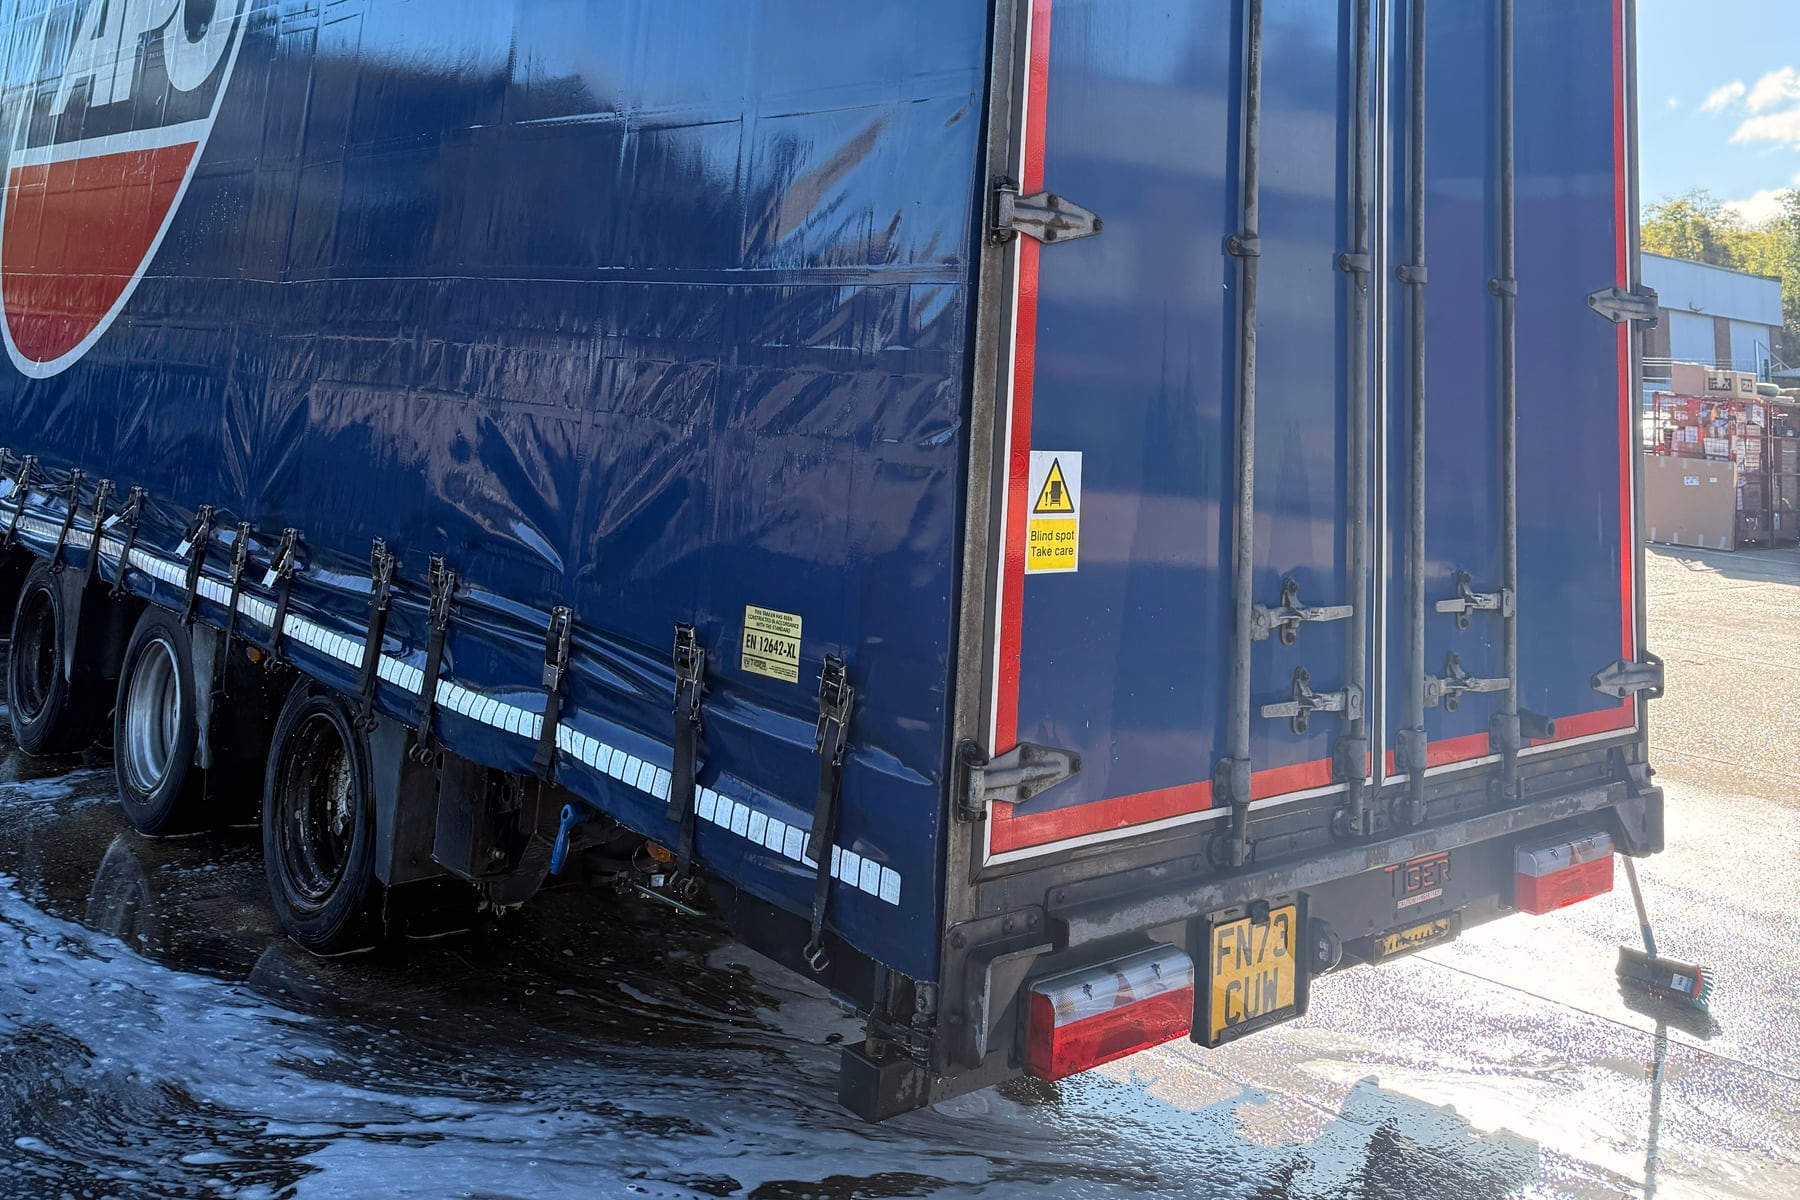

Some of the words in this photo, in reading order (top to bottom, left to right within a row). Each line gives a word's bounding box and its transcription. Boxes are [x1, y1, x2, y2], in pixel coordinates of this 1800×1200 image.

[1031, 530, 1053, 541] Blind
[1056, 531, 1074, 543] spot
[1031, 546, 1052, 557] Take
[1055, 547, 1074, 557] care
[748, 614, 770, 623] CONSTRUCTED
[772, 625, 791, 633] STANDARD
[746, 633, 757, 649] EN
[760, 636, 796, 659] 12642-XL
[1216, 913, 1288, 976] FN73
[1225, 967, 1278, 1026] CUW
